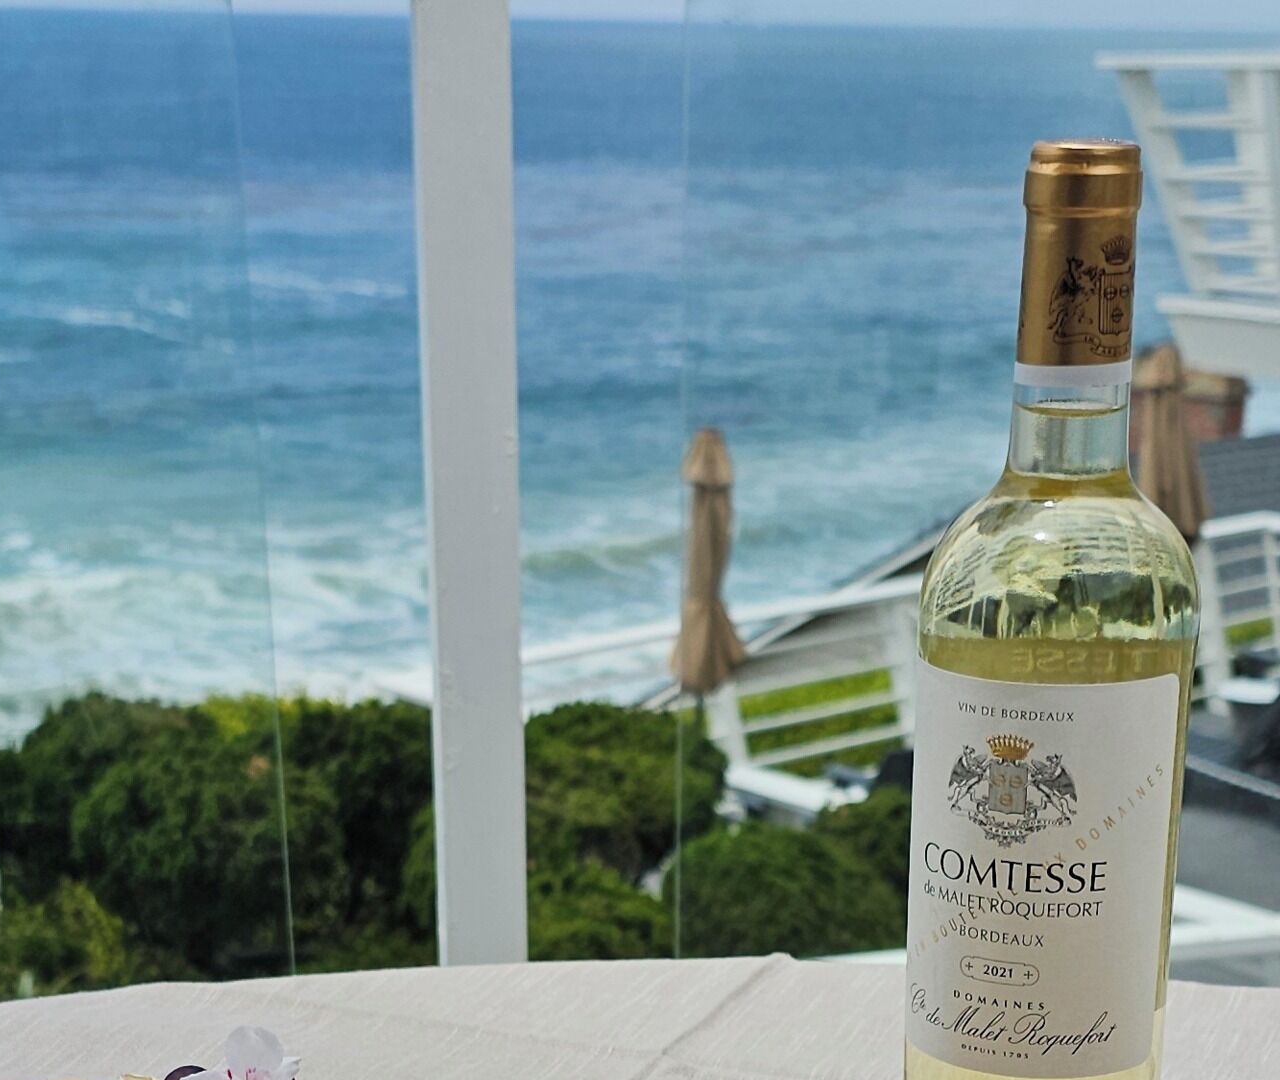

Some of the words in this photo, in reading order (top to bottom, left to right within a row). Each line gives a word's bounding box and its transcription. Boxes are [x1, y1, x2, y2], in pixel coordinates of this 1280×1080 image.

[958, 701, 976, 714] VIN
[981, 706, 996, 717] DE
[1001, 708, 1074, 721] BORDEAUX
[1076, 764, 1163, 850] DOMAINES
[924, 842, 1108, 893] COMTESSE
[924, 880, 935, 896] de
[938, 886, 986, 910] MALET
[989, 897, 1103, 920] ROQUEFORT
[959, 924, 1044, 947] BORDEAUX
[983, 964, 1013, 978] 2021
[953, 989, 1045, 1010] DOMAINES
[926, 1007, 940, 1026] de
[941, 1006, 1008, 1042] Malet
[1008, 1010, 1117, 1056] Roquefort
